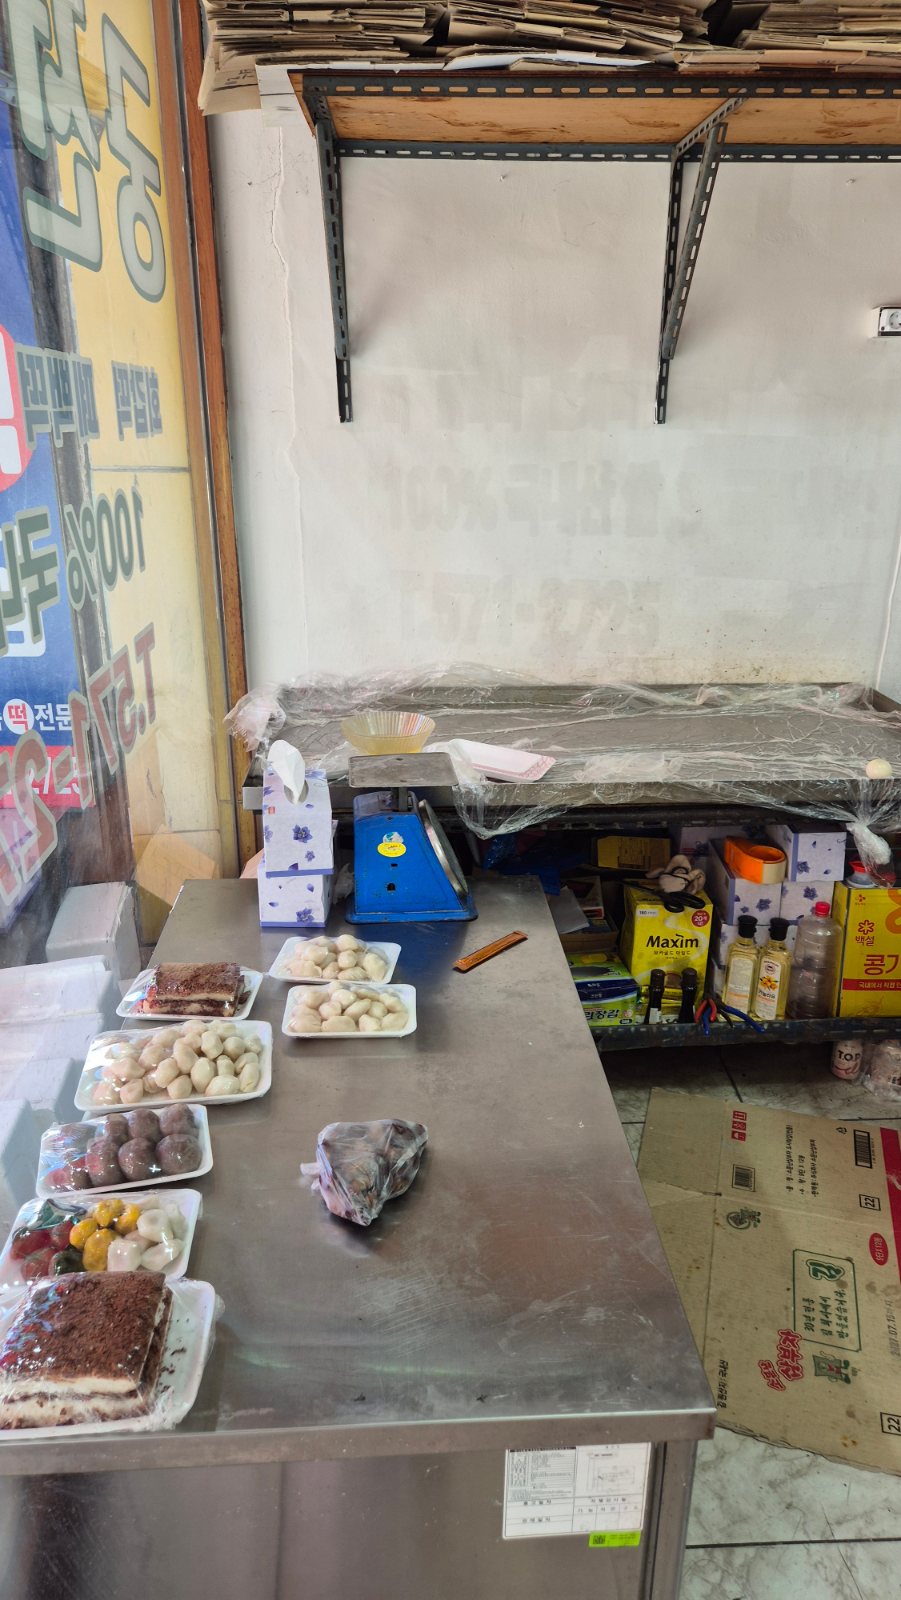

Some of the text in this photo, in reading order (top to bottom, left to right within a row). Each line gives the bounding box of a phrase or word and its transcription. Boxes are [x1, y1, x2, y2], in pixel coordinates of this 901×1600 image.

[646, 933, 699, 948] Maxim
[855, 935, 875, 947] 백설
[864, 1197, 875, 1208] 22
[806, 1260, 844, 1280] 김
[776, 1328, 804, 1381] 삼부자
[757, 1360, 786, 1391] 소문난
[887, 1417, 901, 1433] 22
